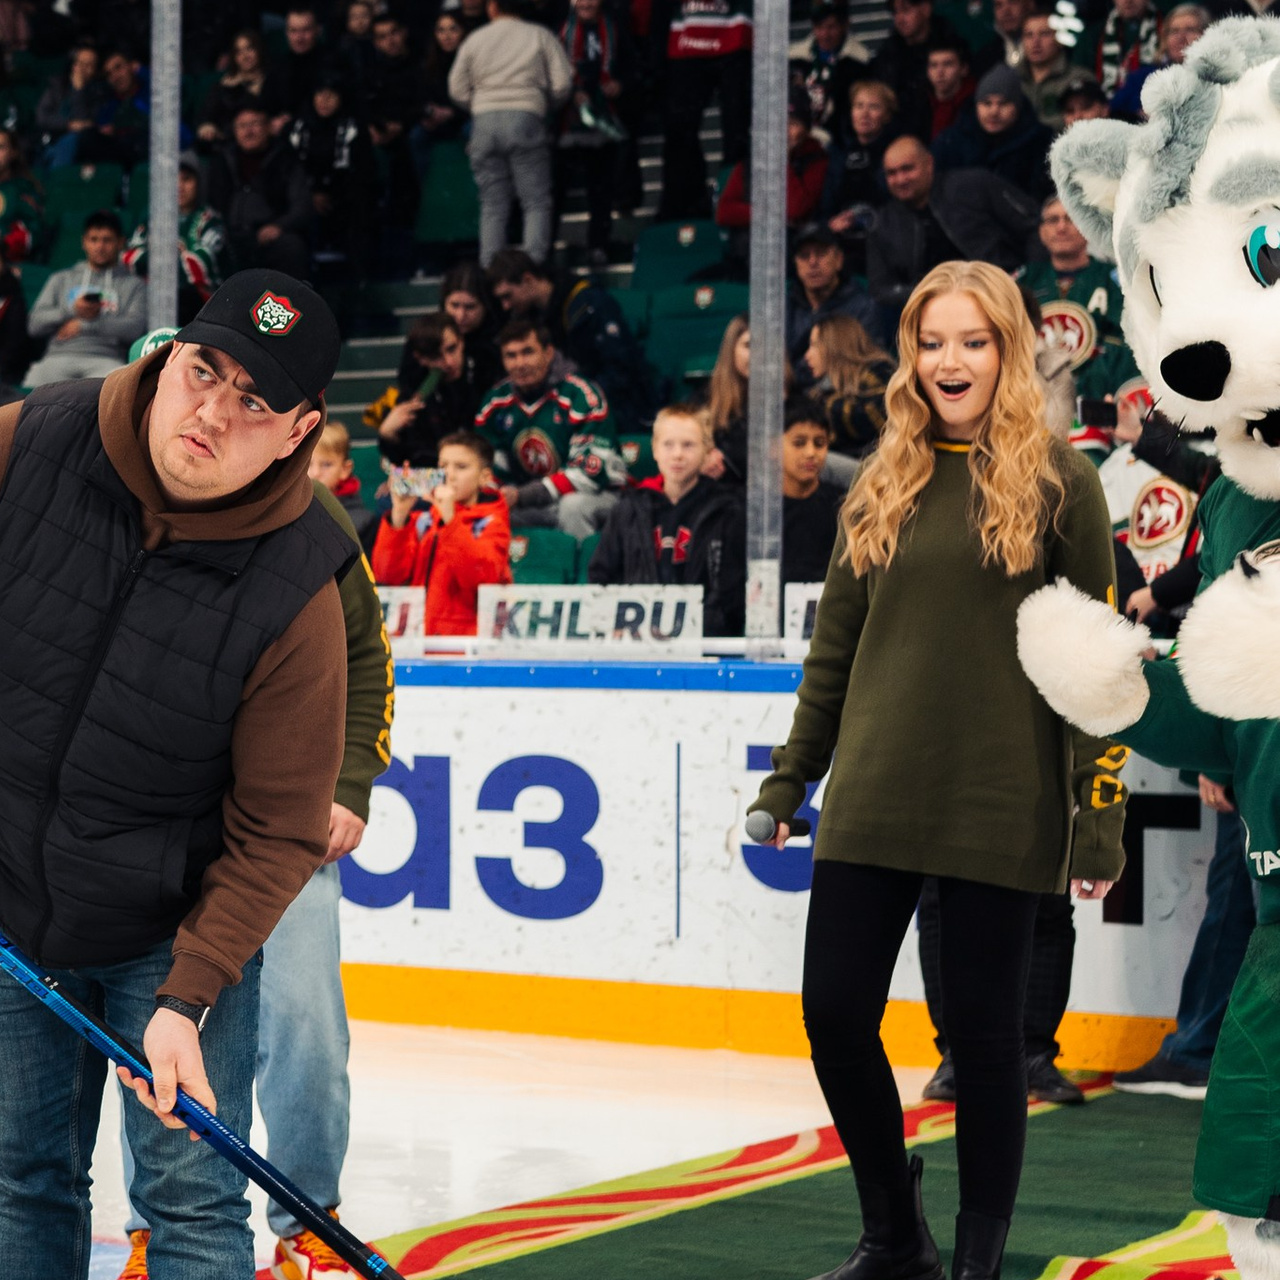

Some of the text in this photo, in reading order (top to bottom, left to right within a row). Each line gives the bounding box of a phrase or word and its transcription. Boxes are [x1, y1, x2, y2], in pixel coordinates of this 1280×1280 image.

[493, 601, 687, 641] KHL.RU
[338, 755, 605, 920] аз
[1249, 849, 1280, 876] TA
